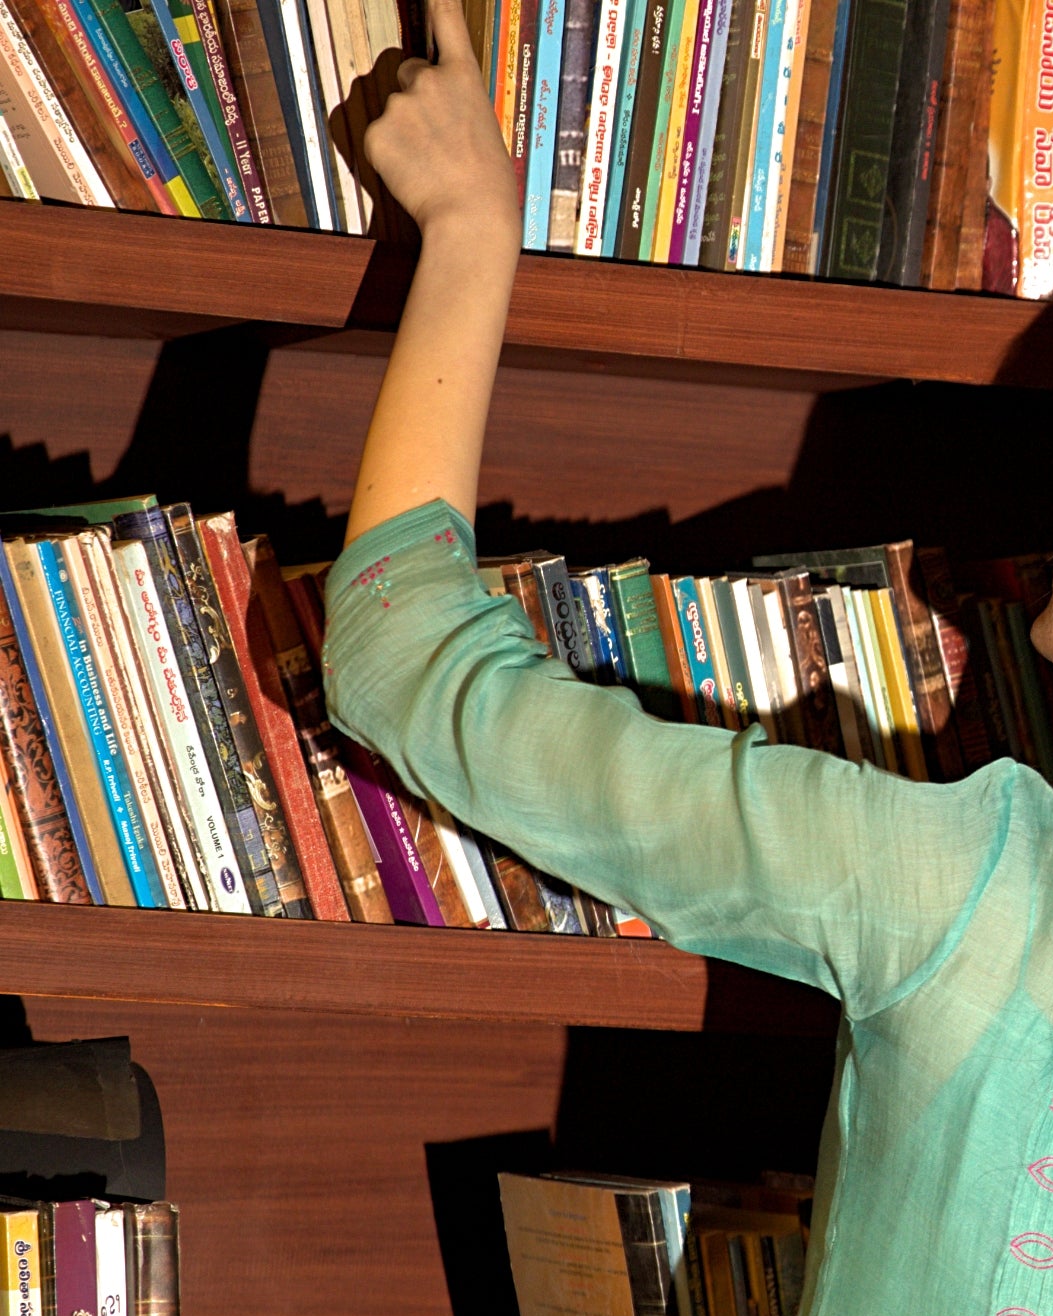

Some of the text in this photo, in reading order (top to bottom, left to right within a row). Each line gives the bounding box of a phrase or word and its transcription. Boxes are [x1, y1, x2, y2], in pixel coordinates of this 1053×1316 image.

[237, 151, 254, 176] Year
[249, 186, 270, 224] PAPER
[53, 590, 77, 655] FINANCIAL
[77, 658, 103, 735] ACCOUNTING
[132, 567, 191, 724] మీ ఆరోగ్యం మీ చేతుల్లోనే
[83, 656, 103, 707] Business
[96, 706, 114, 731] and
[104, 731, 121, 755] Life
[104, 774, 121, 802] Trivedi
[122, 791, 139, 824] Takeshi
[117, 820, 143, 872] Manoj Trivedi
[206, 815, 224, 851] VOLUME
[14, 1240, 32, 1255] శ్రీ
[18, 1258, 31, 1299] లలితా
